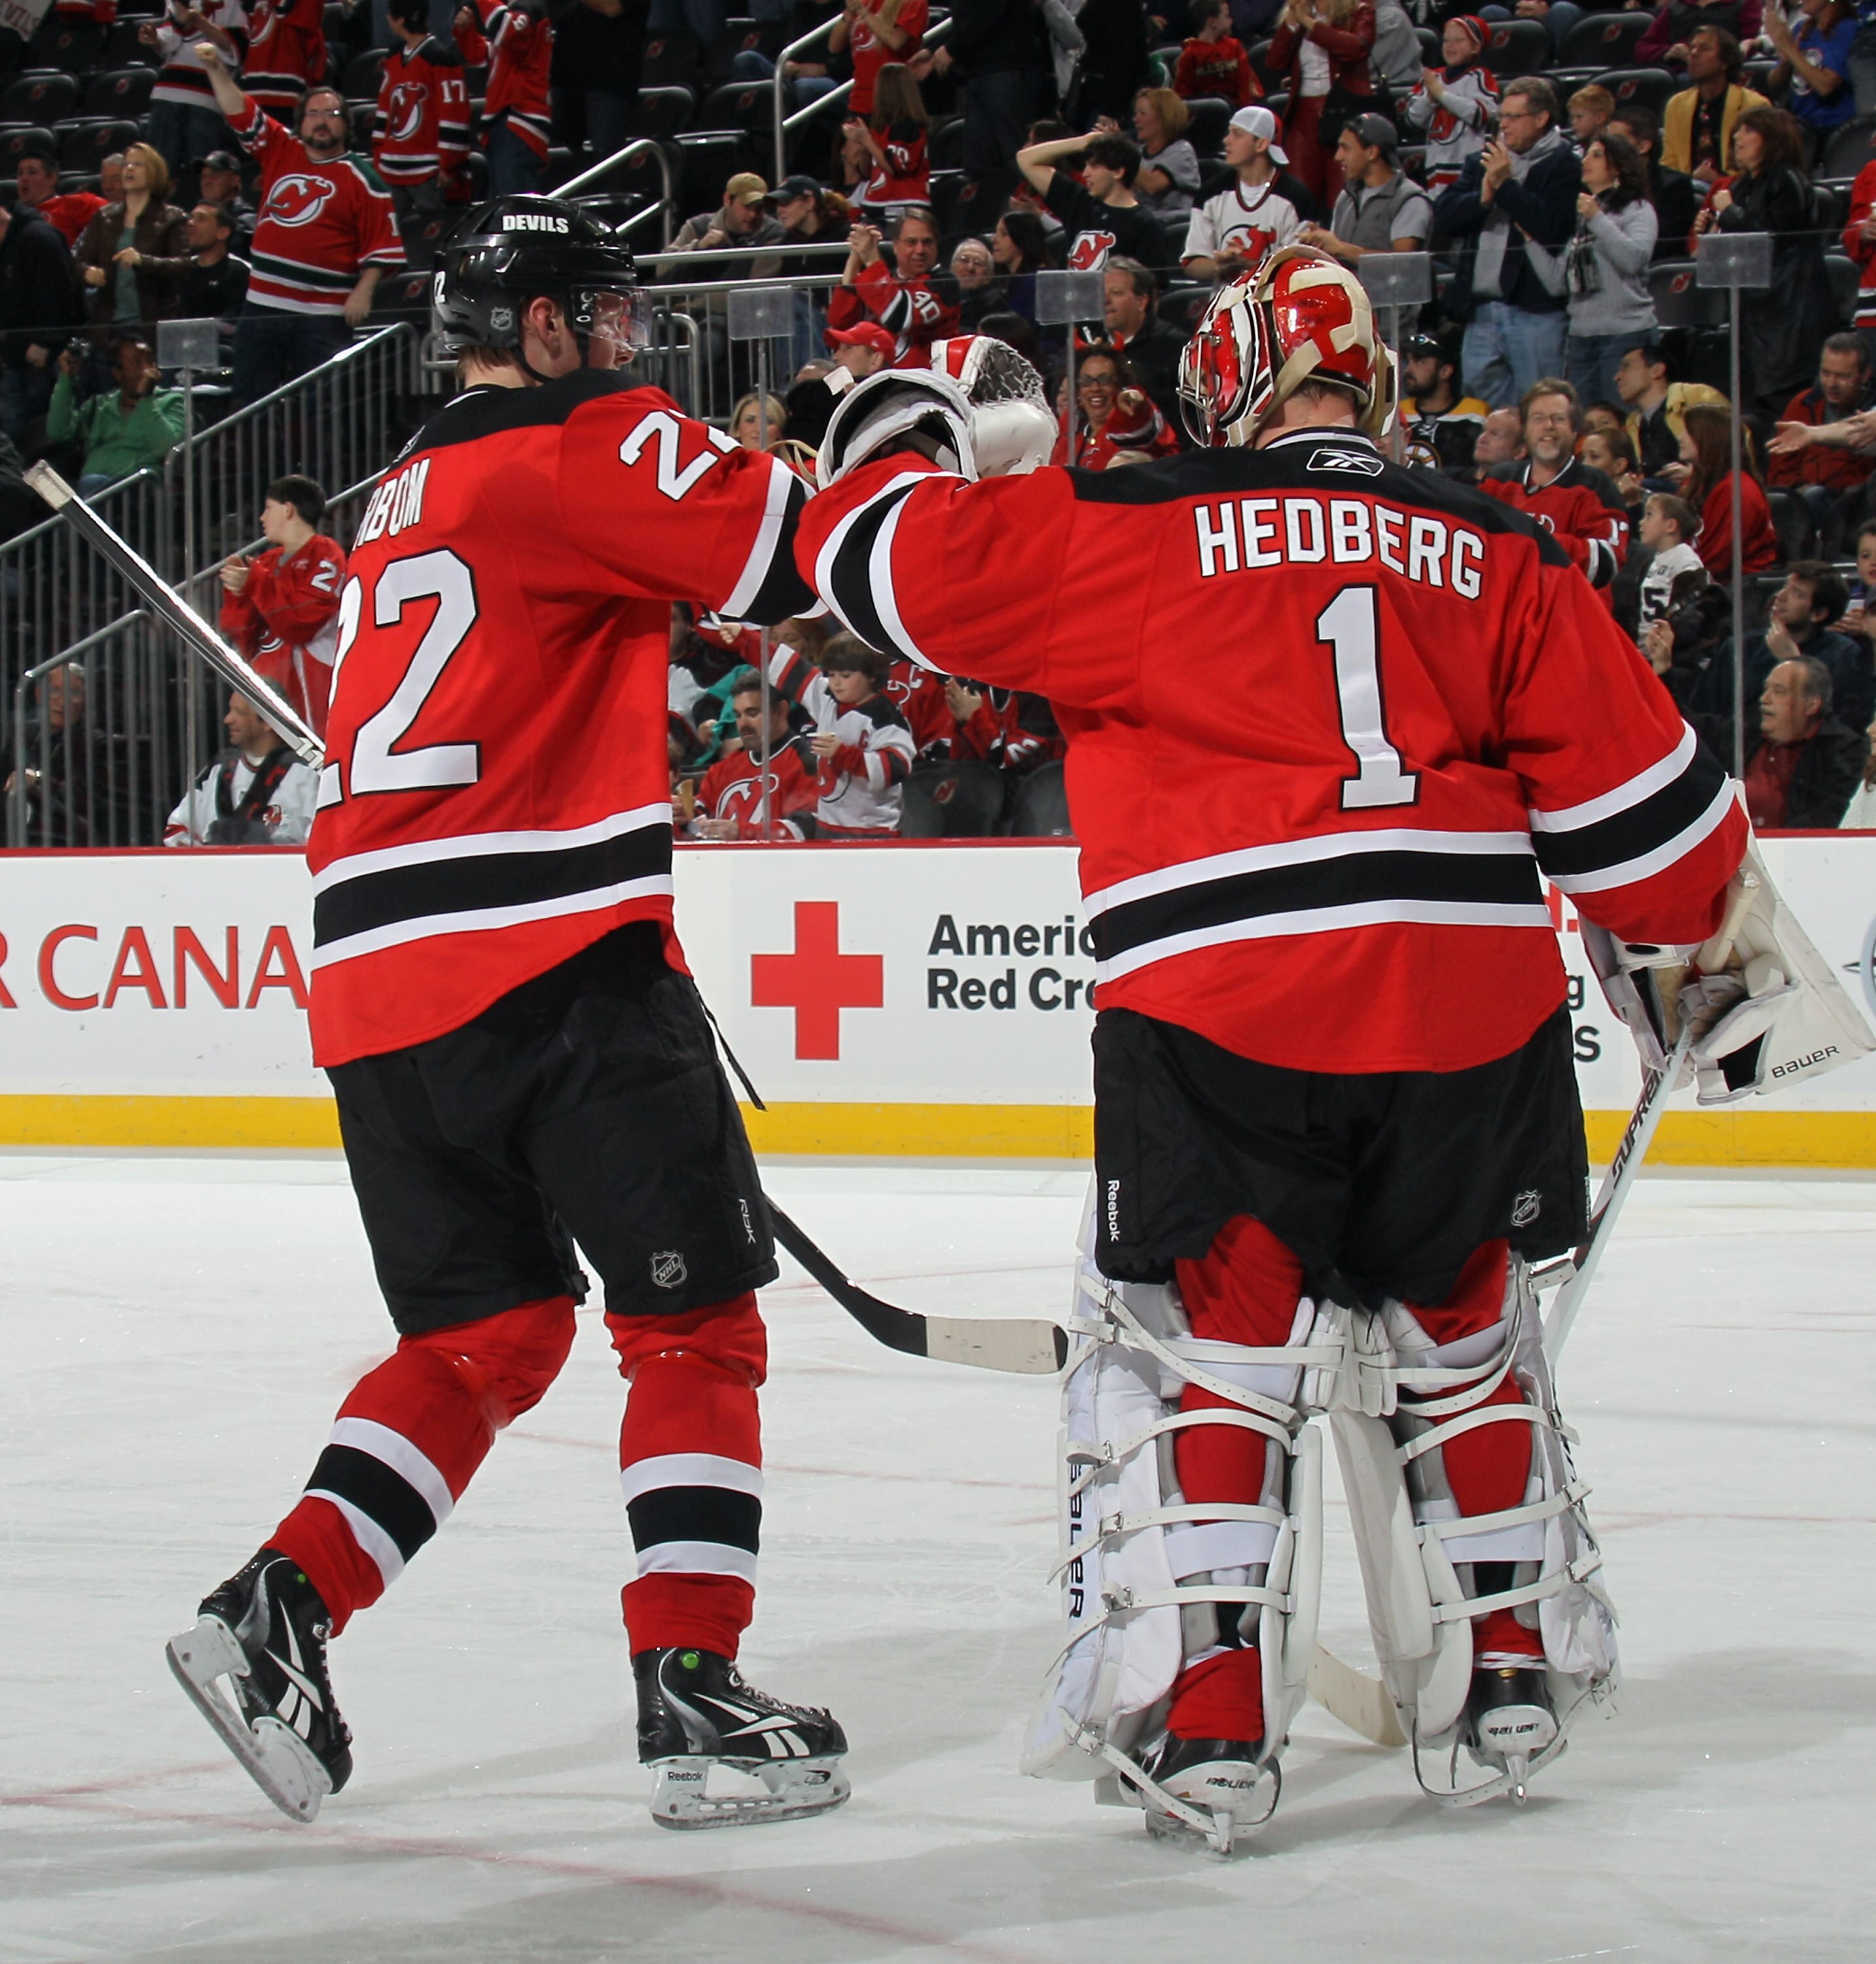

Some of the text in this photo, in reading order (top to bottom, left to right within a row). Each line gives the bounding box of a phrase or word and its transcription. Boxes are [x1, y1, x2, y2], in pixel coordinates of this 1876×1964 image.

[442, 79, 464, 103] 17
[502, 215, 569, 234] DEVILS
[1194, 498, 1485, 600] HEDBERG
[1316, 585, 1419, 809] 1
[37, 924, 309, 1010] CANA
[928, 968, 1015, 1010] Red
[1107, 1180, 1121, 1242] Reebok
[658, 1260, 679, 1281] NHL
[668, 1772, 704, 1782] Reebok
